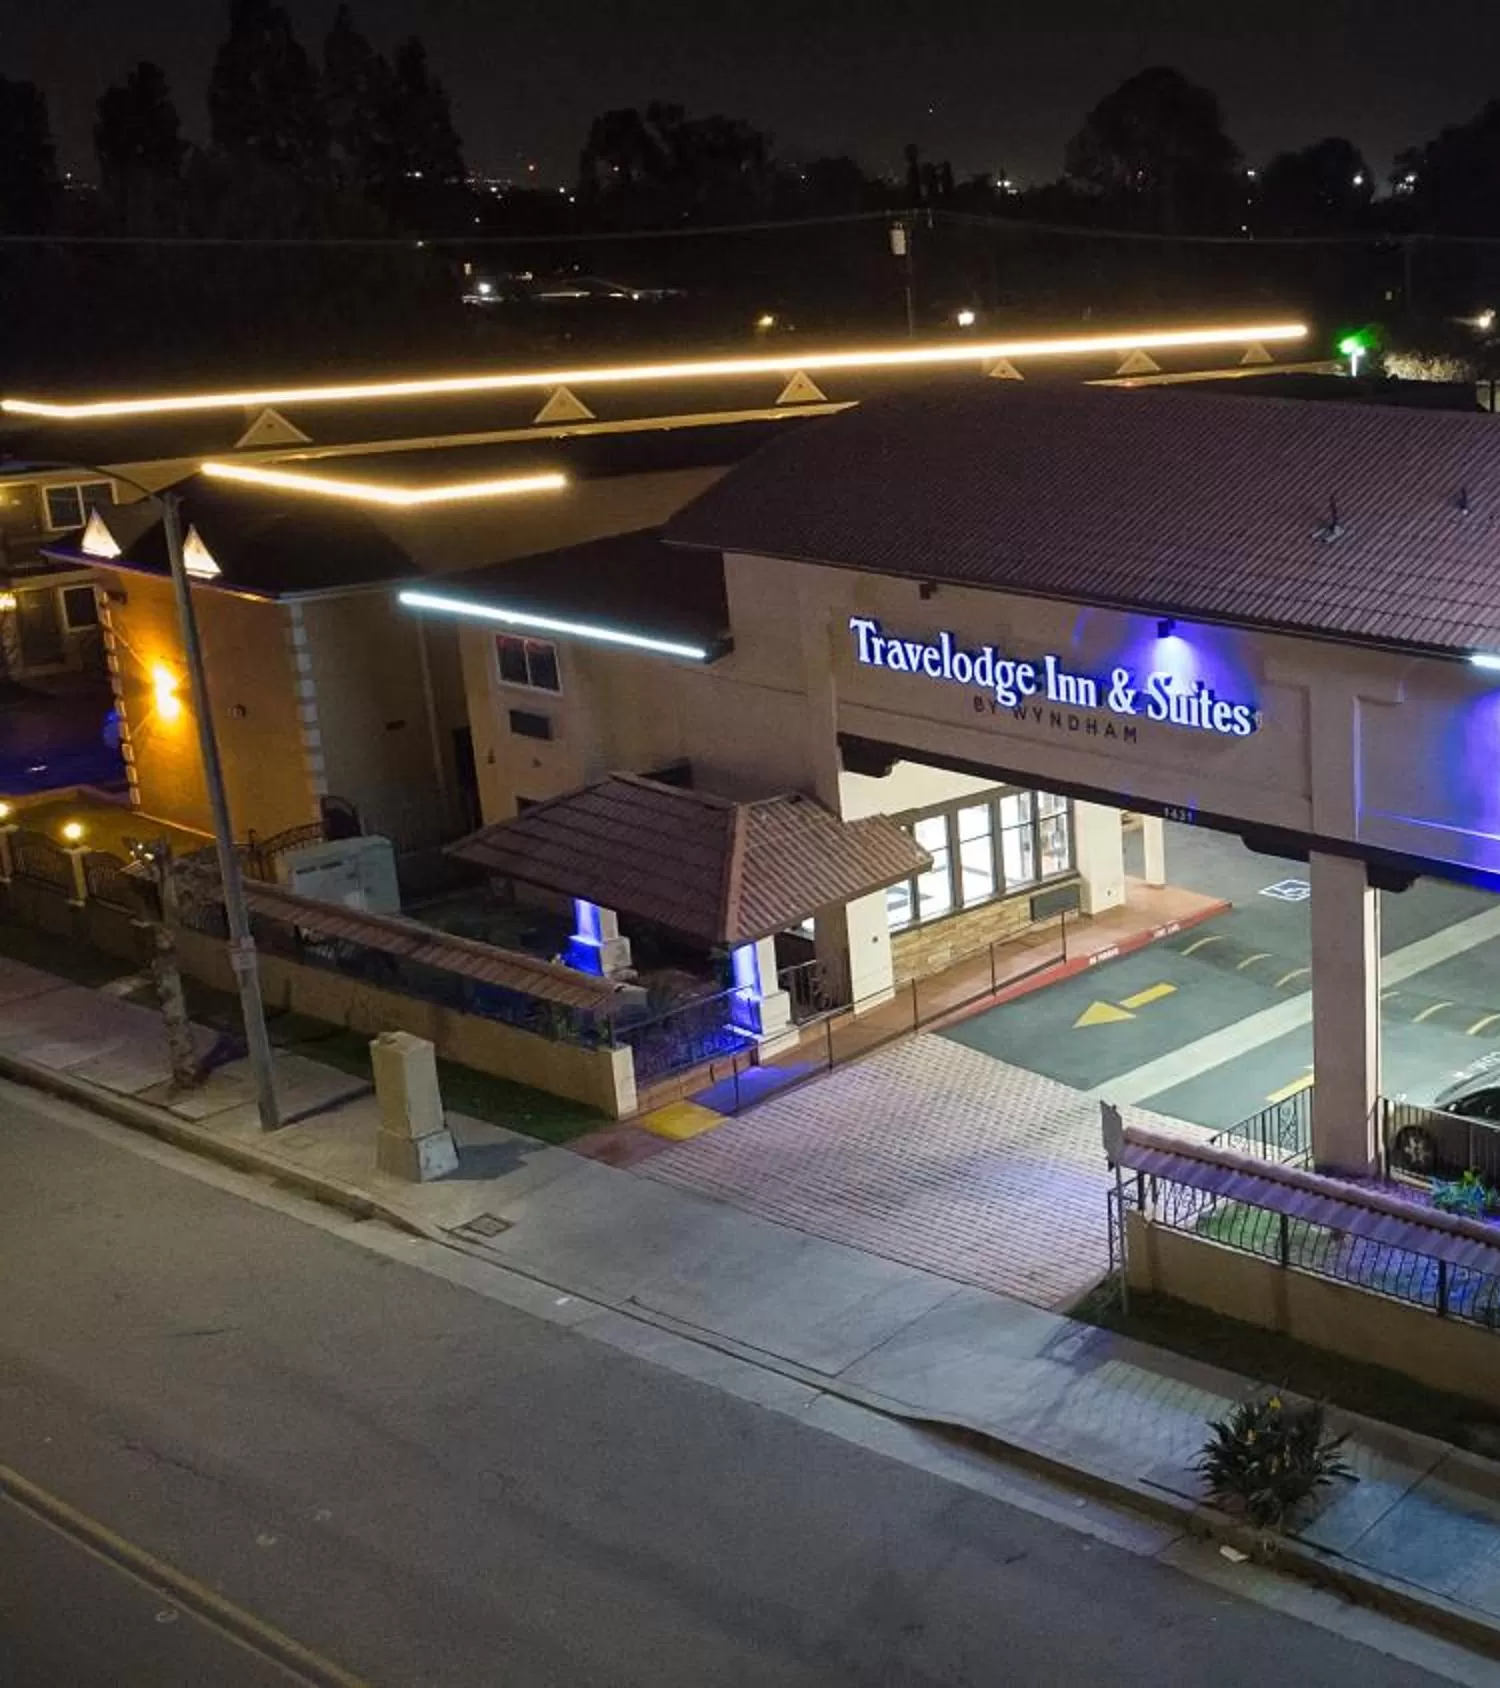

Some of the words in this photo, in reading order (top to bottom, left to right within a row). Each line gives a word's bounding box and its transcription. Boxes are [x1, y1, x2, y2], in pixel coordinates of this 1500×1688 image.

[849, 616, 1037, 707] Travelodge
[1043, 655, 1097, 709] Inn
[1107, 668, 1139, 715] &
[1147, 671, 1252, 735] Suites
[973, 694, 998, 715] BY
[1012, 704, 1138, 744] WYNDHAM
